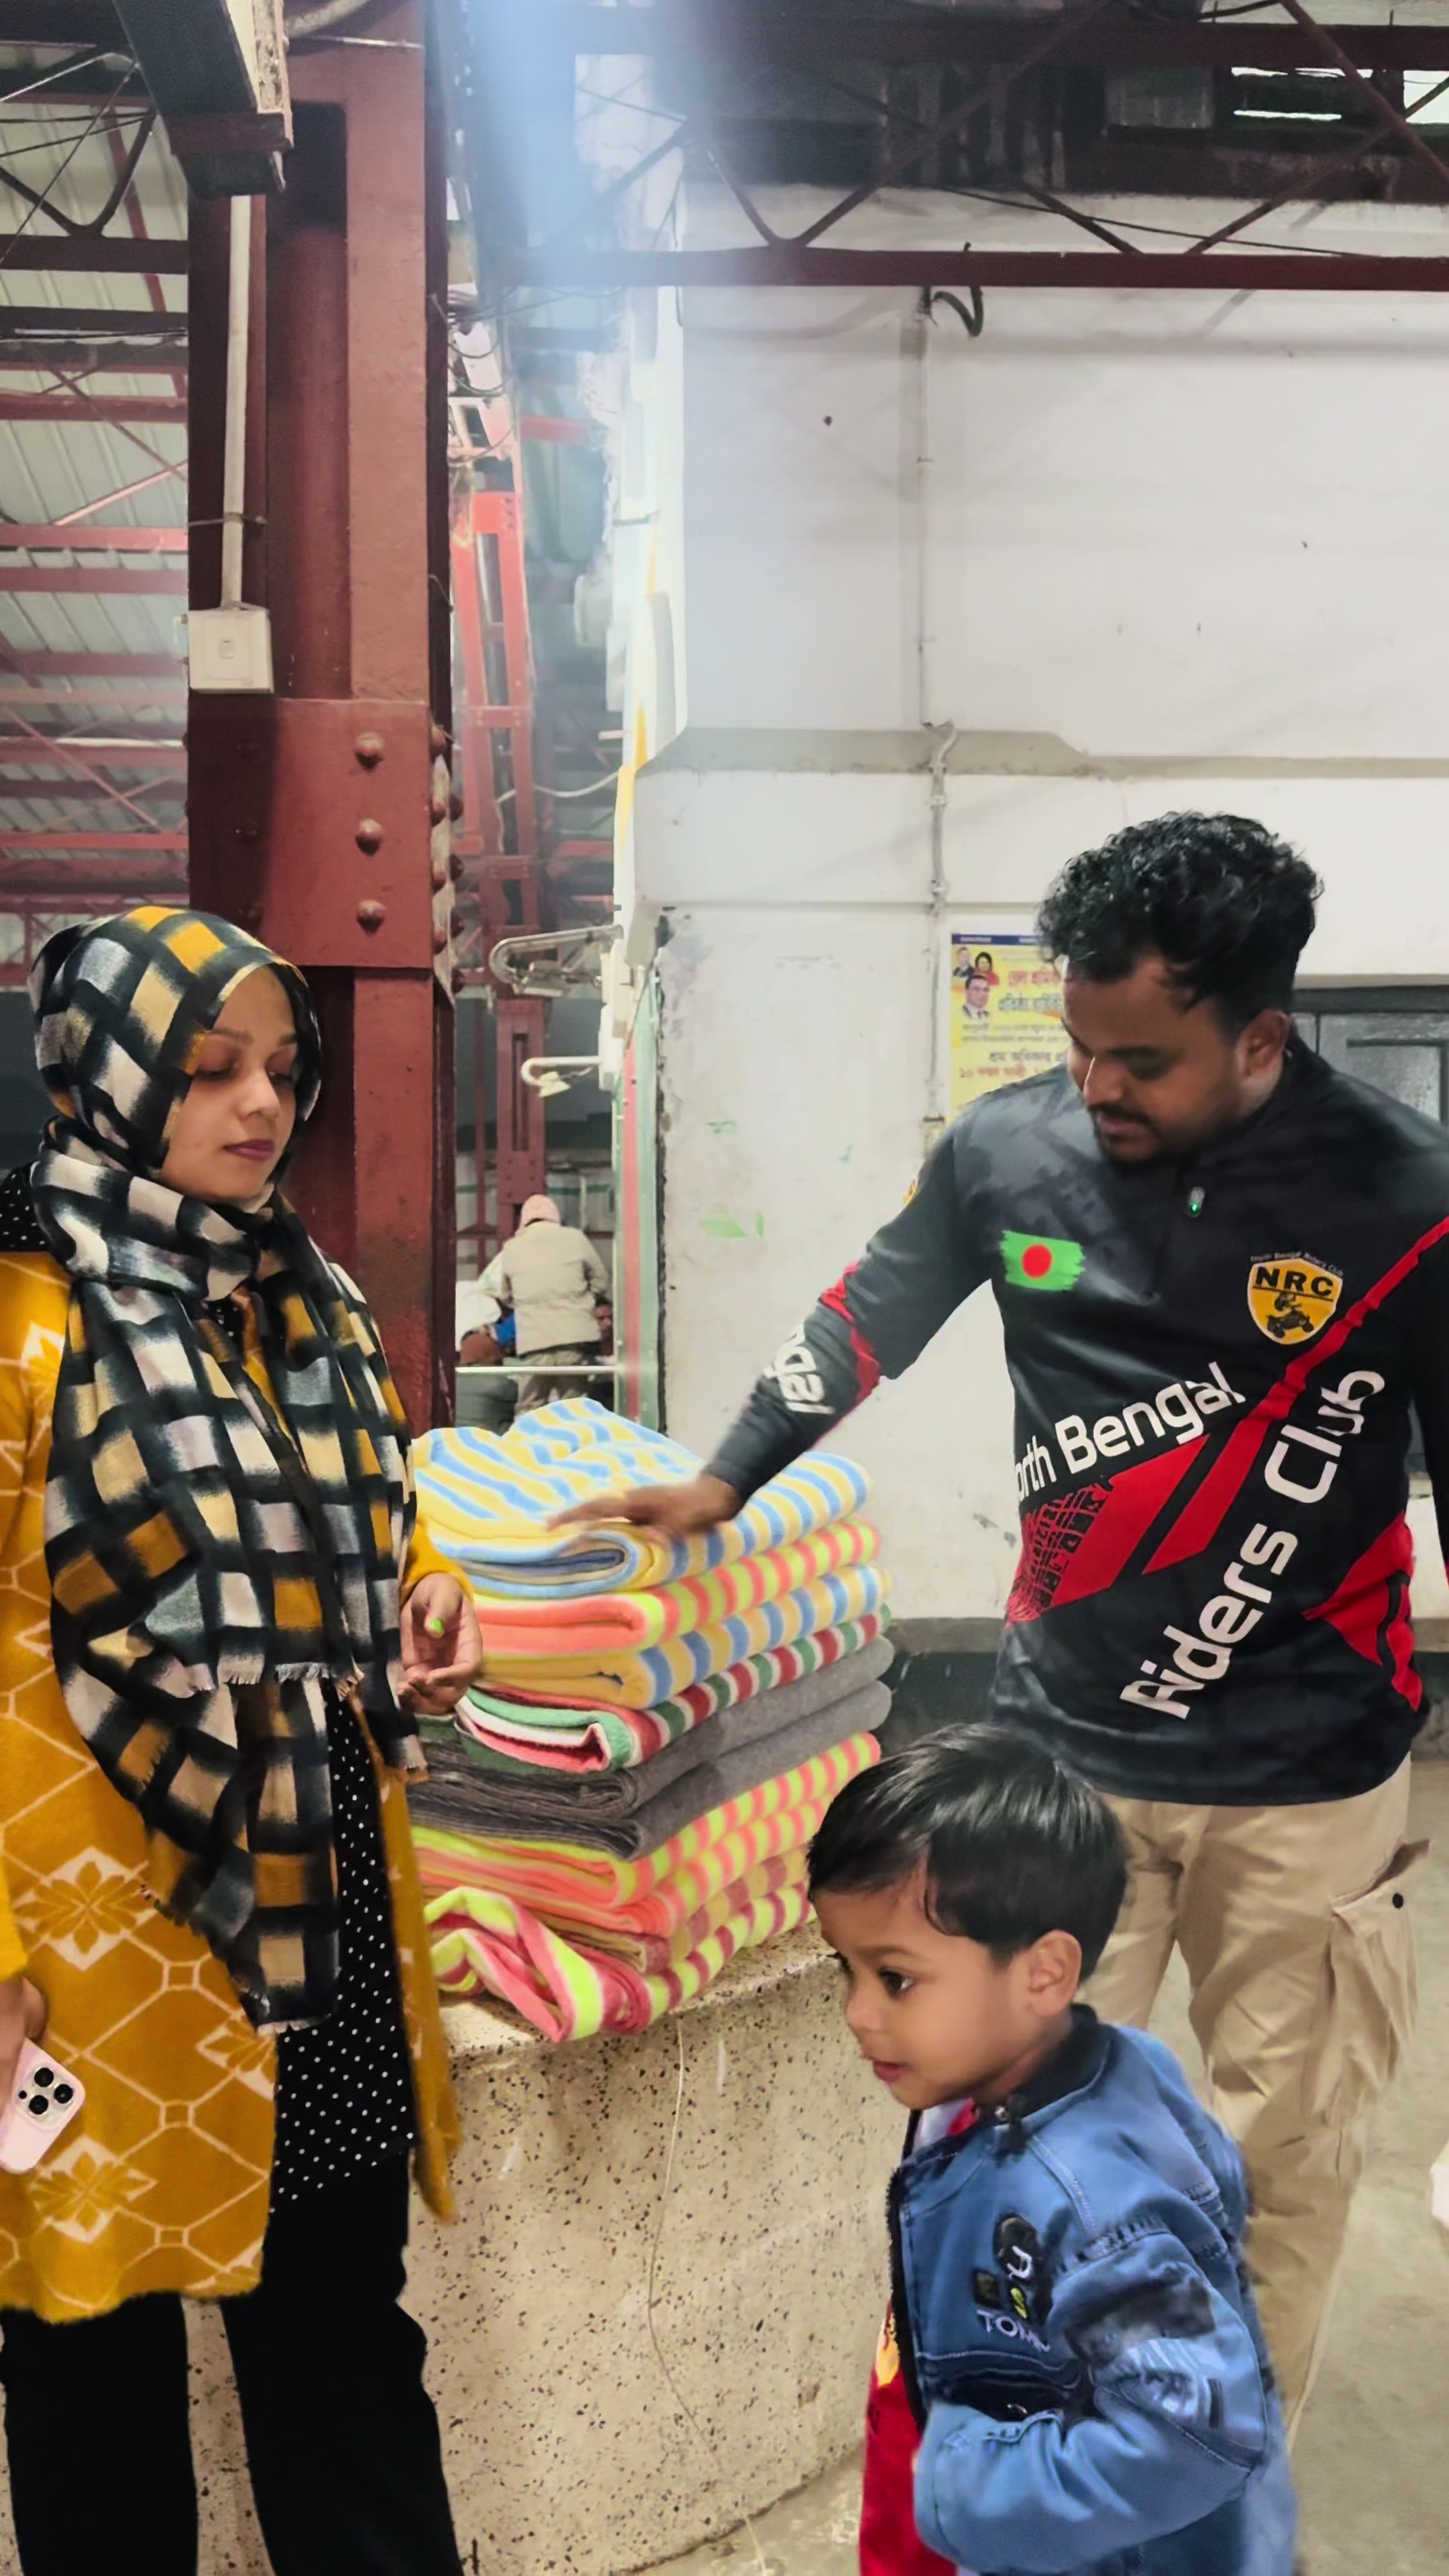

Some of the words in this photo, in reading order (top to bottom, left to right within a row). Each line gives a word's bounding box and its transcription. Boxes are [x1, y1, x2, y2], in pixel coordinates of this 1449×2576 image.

[1255, 1266, 1334, 1297] NRC
[1015, 1435, 1057, 1502] orth
[1055, 1361, 1246, 1474] Bengal
[1120, 1523, 1298, 1720] Riders
[1265, 1370, 1385, 1503] Club
